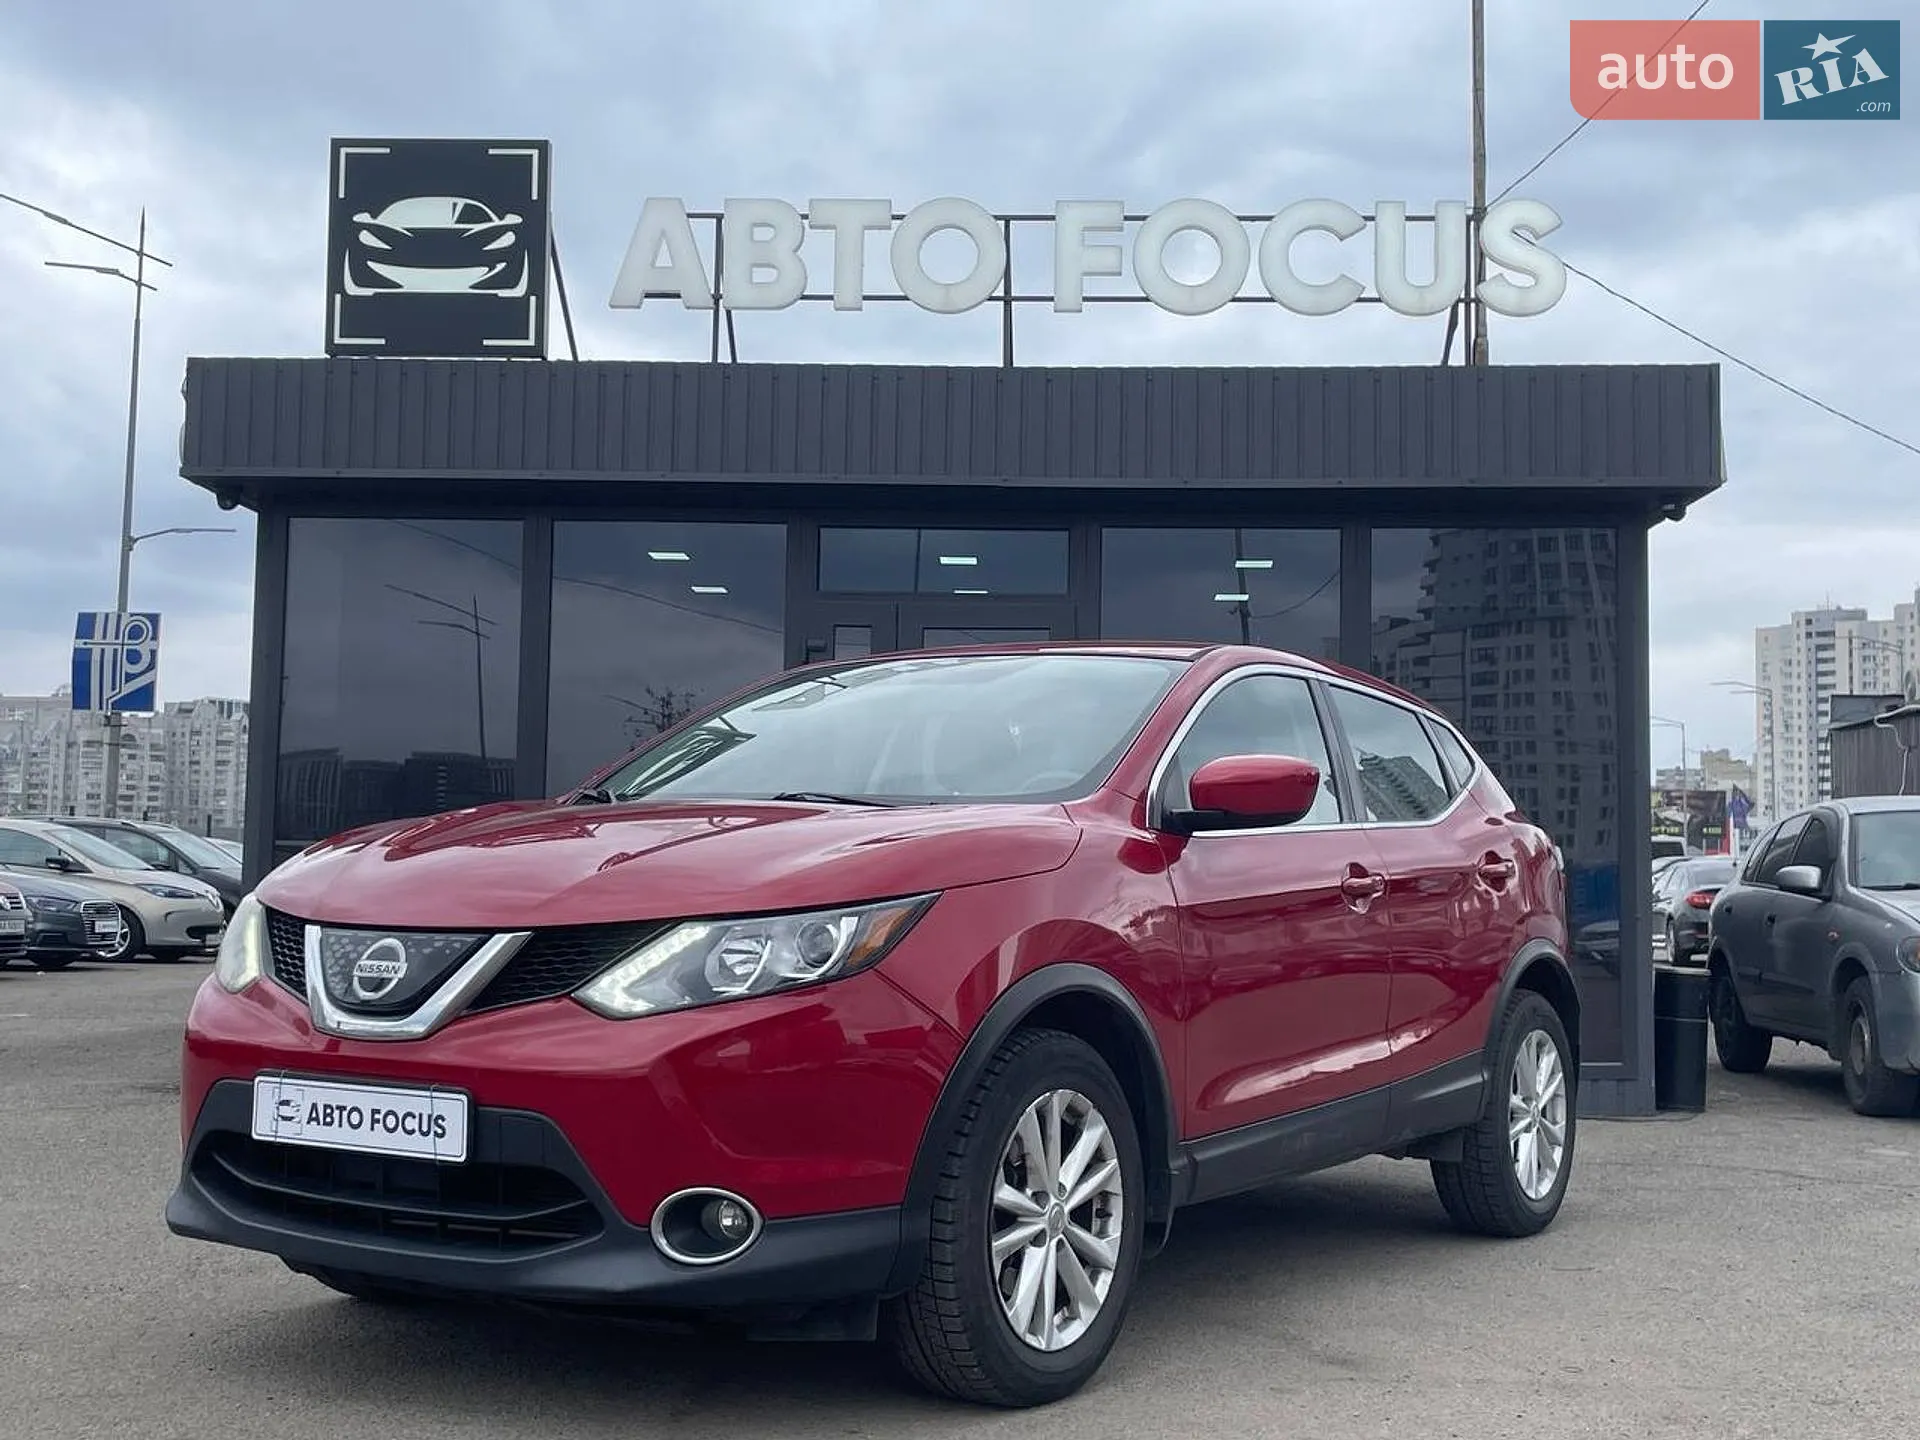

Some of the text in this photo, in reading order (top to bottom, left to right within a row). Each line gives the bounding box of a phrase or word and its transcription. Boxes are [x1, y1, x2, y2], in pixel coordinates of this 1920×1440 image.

[608, 196, 1567, 317] АВТО FOCUS
[356, 963, 401, 976] NISSAN
[306, 1102, 447, 1139] АВТО FOCUS
